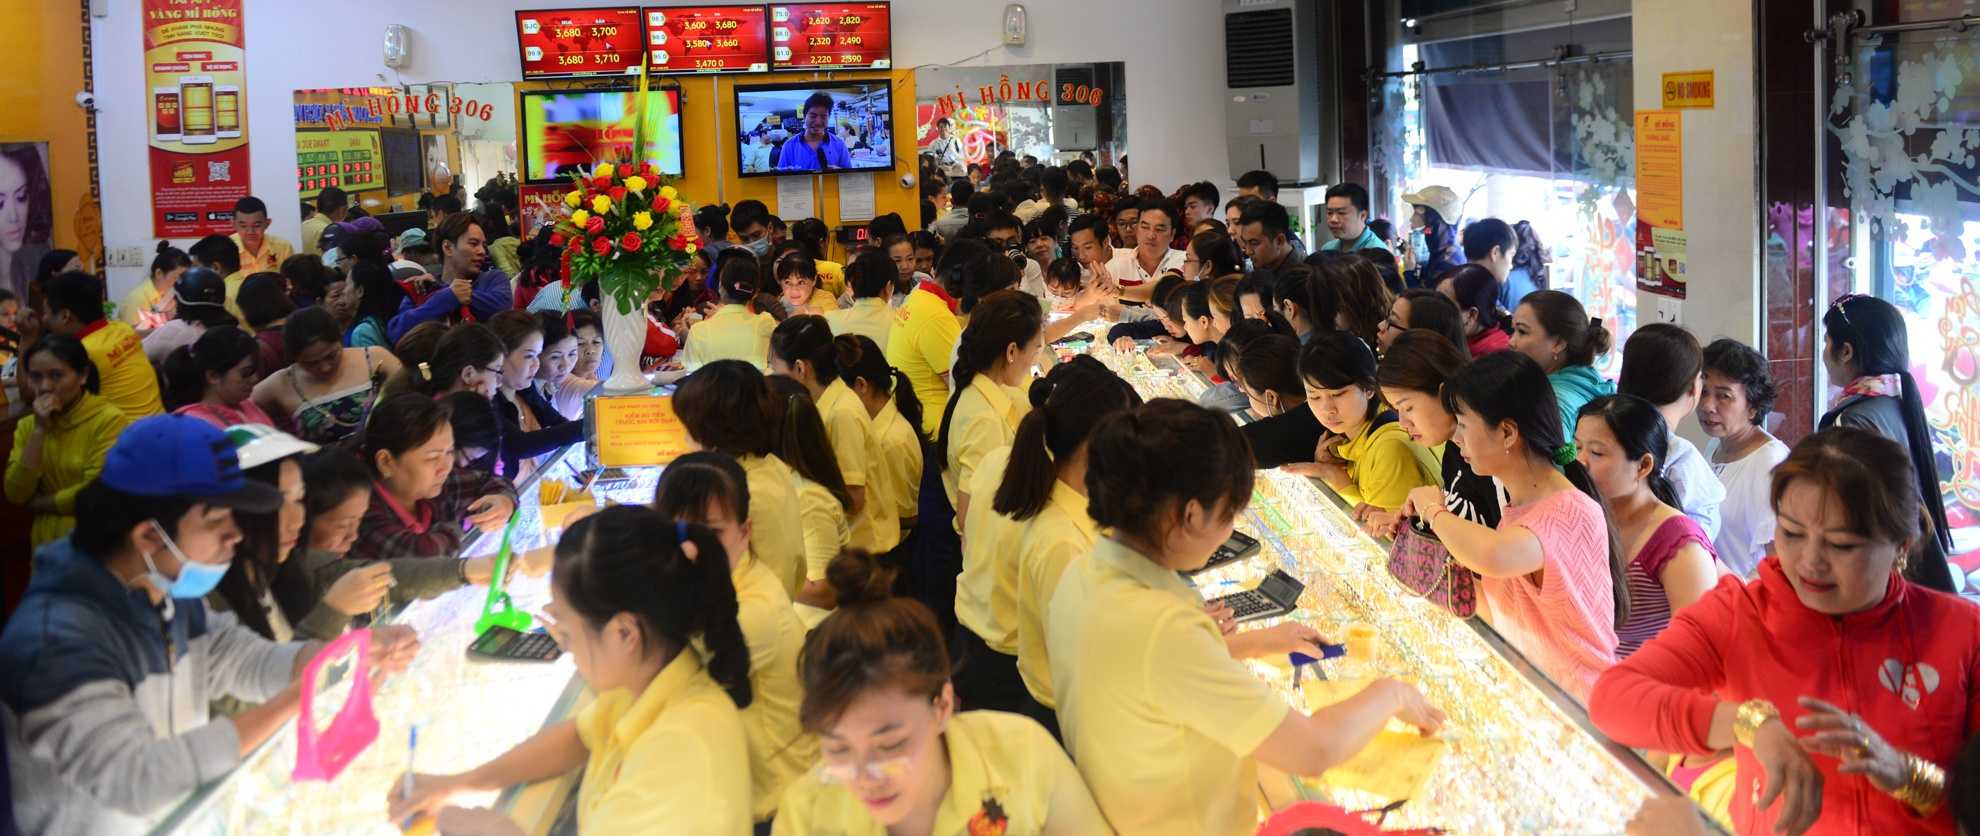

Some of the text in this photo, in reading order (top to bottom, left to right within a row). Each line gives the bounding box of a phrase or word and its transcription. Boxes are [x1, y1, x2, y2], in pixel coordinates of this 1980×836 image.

[149, 8, 182, 19] VÀNG
[203, 4, 237, 18] HỒNG
[684, 20, 737, 30] 3,600 3,680
[809, 16, 860, 26] 2,620 2,820
[555, 26, 617, 39] 3,680 3,700
[685, 38, 738, 48] 3,580 3,660
[809, 36, 861, 46] 2,320 2,490
[558, 53, 620, 66] 3,680 3,710
[695, 59, 716, 69] 3,470
[810, 54, 862, 64] 2,220 2,390
[978, 73, 1050, 105] HỒNG
[1062, 82, 1103, 107] 306
[1677, 81, 1711, 99] NO SMOKING
[366, 87, 441, 118] HỒNG
[449, 96, 494, 122] 306
[542, 189, 567, 203] HỒN
[652, 410, 666, 418] TIỀN
